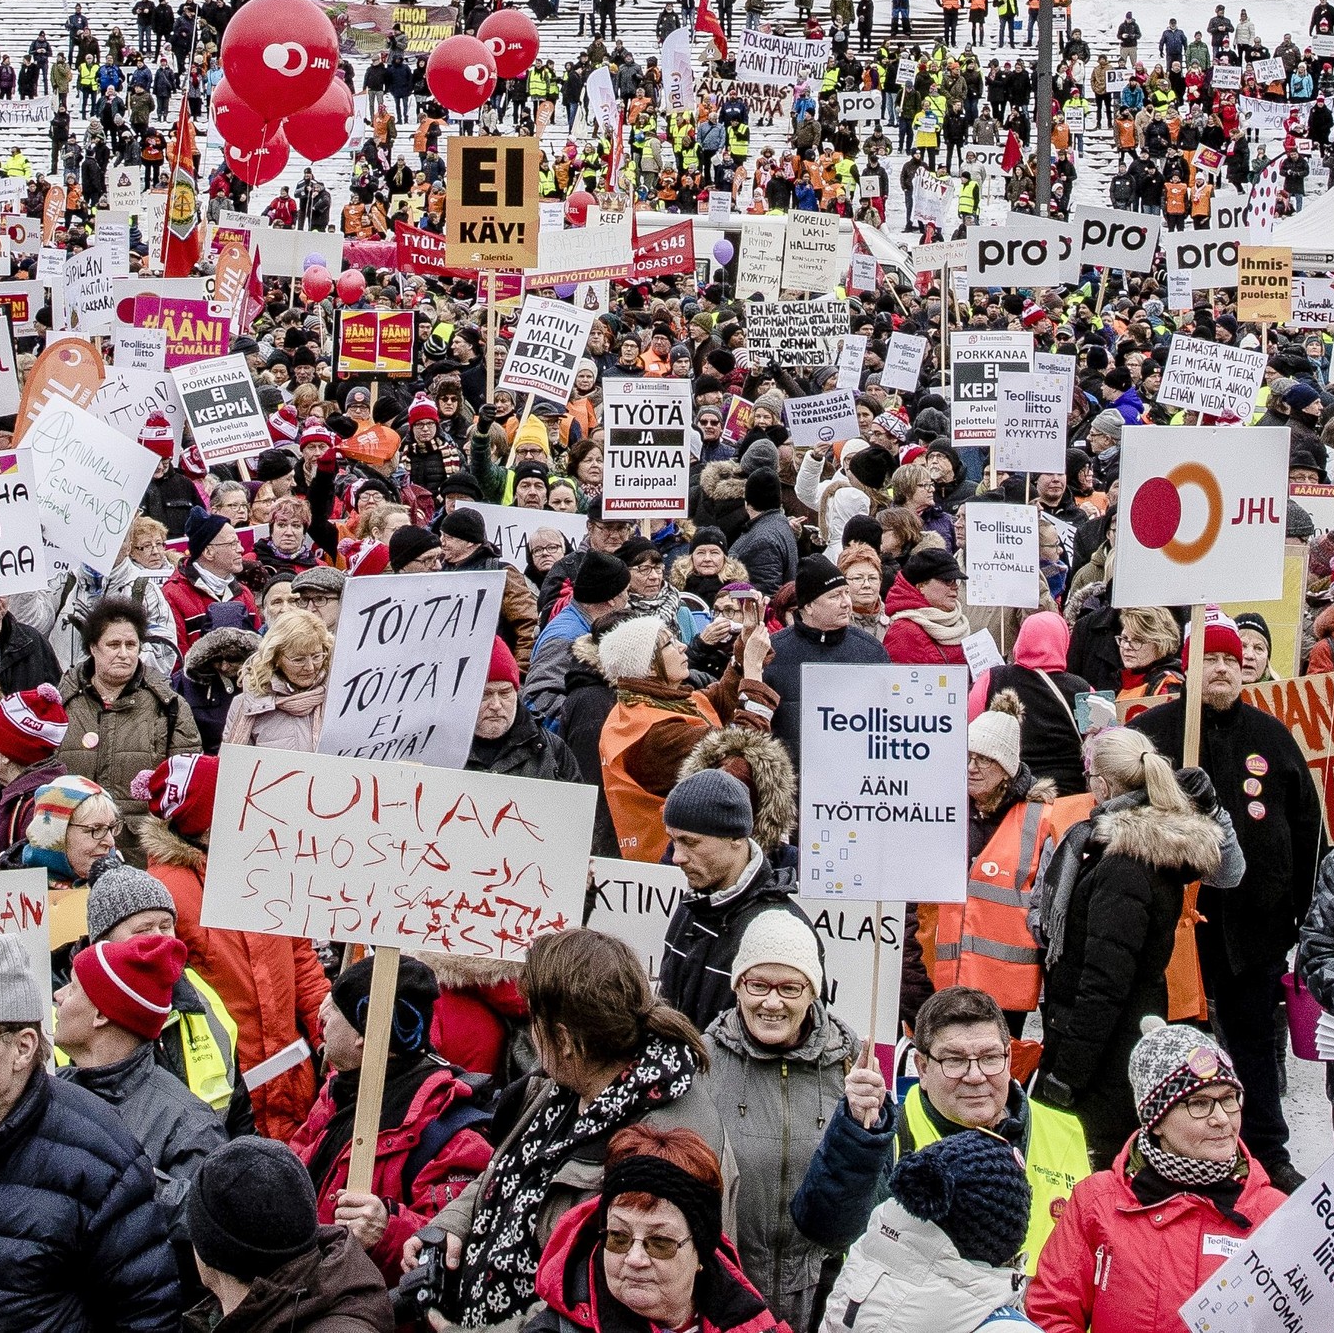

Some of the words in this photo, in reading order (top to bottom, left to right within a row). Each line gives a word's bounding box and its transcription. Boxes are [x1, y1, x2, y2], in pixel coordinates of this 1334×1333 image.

[744, 31, 779, 51] TOLKKUA
[782, 40, 825, 58] HALLITUS
[311, 58, 331, 69] JHL
[739, 50, 766, 72] ÄÄNI
[216, 105, 229, 114] JHL
[843, 97, 875, 113] pro
[254, 147, 270, 155] JHL
[461, 148, 524, 207] EI
[599, 213, 623, 225] KEEP
[793, 214, 835, 225] KOKEILU-
[26, 231, 39, 240] JHL
[460, 218, 524, 244] KÄY!
[802, 228, 829, 237] LAKI-
[1082, 219, 1147, 251] pro
[653, 235, 685, 252] 1945
[790, 240, 835, 252] HALLITUS
[480, 253, 513, 262] Talentia
[979, 239, 1048, 273] pro
[1178, 241, 1240, 269] pro
[1241, 258, 1289, 273] Ihmis-
[531, 266, 628, 287] #ÄÄNITYÖTTÖMÄLLE
[1241, 275, 1289, 287] arvon
[1241, 290, 1288, 301] puolesta!
[143, 309, 222, 342] #ÄÄNI
[525, 313, 584, 341] AKTIIVI-
[120, 339, 161, 351] Teollisuus
[527, 329, 574, 352] MALLI
[135, 349, 155, 358] liitto
[956, 349, 1028, 360] PORKKANAA
[1175, 338, 1218, 358] ELÄMÄSTÄ
[1223, 350, 1263, 368] HALLITUS
[182, 371, 246, 391] PORKKANAA
[509, 360, 570, 386] ROSKIIN
[212, 386, 227, 403] EI
[791, 401, 819, 411] LUOKAA
[822, 393, 850, 406] LISÄÄ
[1004, 390, 1062, 405] Teollisuus
[195, 401, 253, 423] KEPPIÄ
[610, 401, 685, 426] TYÖTÄ
[791, 402, 853, 419] TYÖPAIKKOJA,
[1025, 402, 1051, 415] liitto
[209, 421, 249, 435] Palveluita
[1005, 418, 1015, 427] JO
[1017, 418, 1059, 429] RIITTÄÄ
[638, 430, 654, 445] JA
[1006, 429, 1058, 440] KYYKYTYS
[608, 451, 685, 468] TURVAA
[614, 474, 625, 487] Ei
[628, 474, 677, 489] raippaa!
[610, 499, 681, 510] #ÄÄNITYÖTTÖMÄLLE
[1231, 497, 1279, 525] JHL
[973, 521, 1033, 535] Teollisuus
[996, 532, 1023, 546] liitto
[992, 551, 1015, 562] ÄÄNI
[971, 562, 1035, 574] TYÖTTÖMÄLLE
[356, 588, 488, 652] TÖITÄ!
[22, 717, 45, 733] PAM
[369, 710, 401, 739] EI
[817, 706, 953, 734] Teollisuus
[867, 734, 931, 761] liitto
[859, 776, 909, 797] ÄÄNI
[238, 759, 544, 842] KUHAA
[811, 803, 957, 824] TYÖTTÖMÄLLE
[881, 1224, 902, 1238] PEAK
[1283, 1263, 1315, 1305] ÄÄNI
